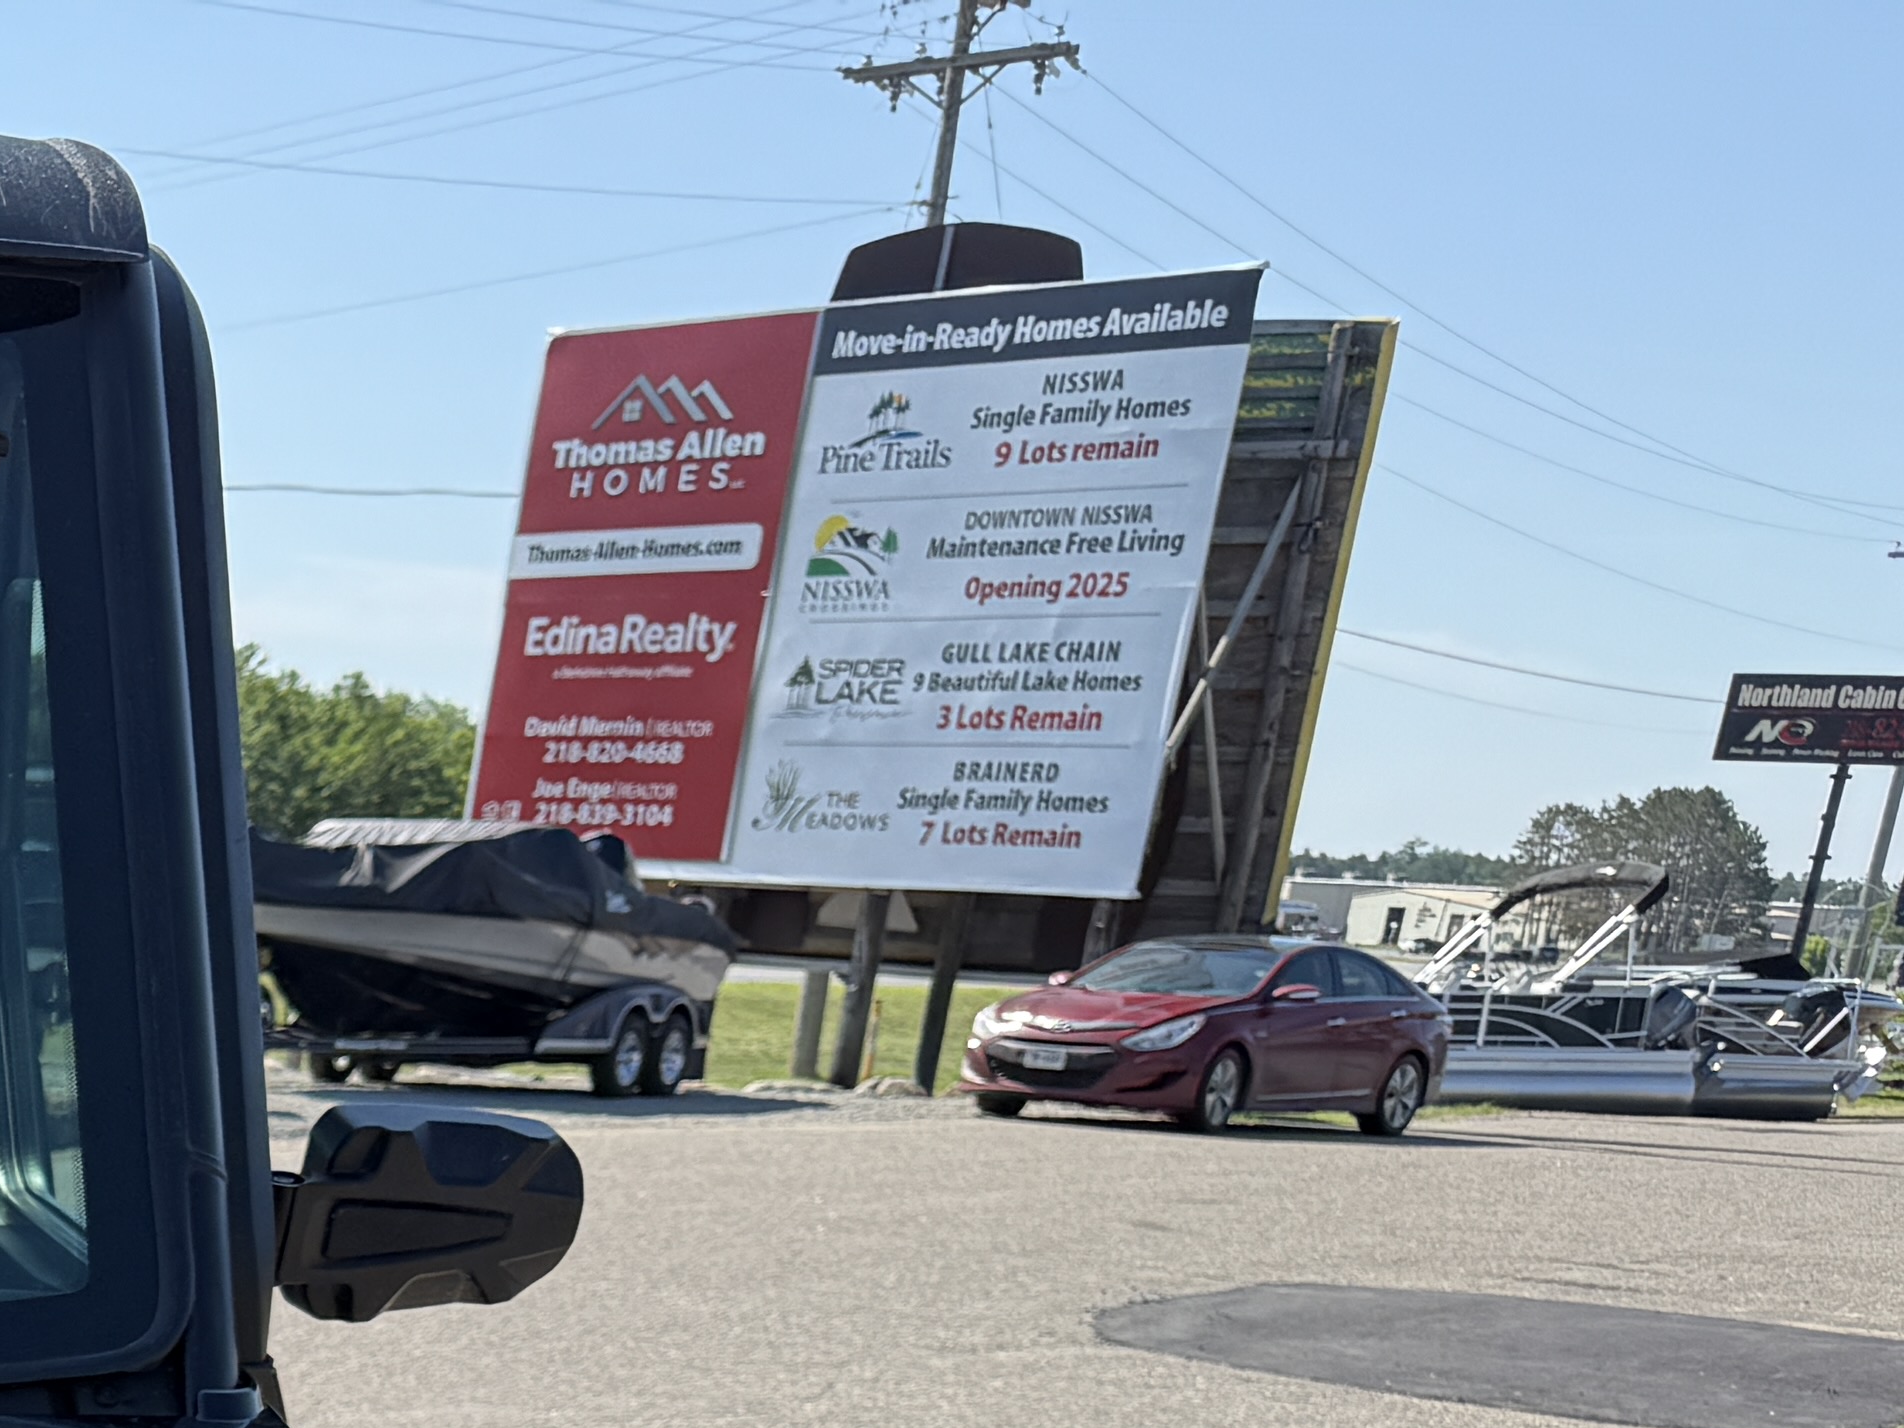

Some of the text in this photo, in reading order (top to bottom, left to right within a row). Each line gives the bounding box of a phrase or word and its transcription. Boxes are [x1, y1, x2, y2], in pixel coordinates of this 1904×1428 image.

[832, 299, 1230, 360] Move-in-Ready Homes Available
[1042, 368, 1125, 396] NISSWA
[970, 397, 1191, 433] Single Family Homes
[552, 427, 767, 470] Thomas Allen
[817, 440, 953, 475] Pine Trails
[993, 432, 1160, 468] 9 Lots remain
[569, 462, 732, 499] HOMES
[964, 504, 1153, 531] DOWNTOWN NISSWA
[926, 530, 1185, 560] Maintenance Free Living
[800, 579, 890, 601] NISSWA
[964, 571, 1131, 605] Opening 2025
[941, 640, 1122, 664] GULL LAKE CHAIN
[817, 658, 906, 680] SPIDER
[913, 669, 1143, 692] 9 Beautiful Lake Homes
[814, 680, 903, 705] LAKE
[1738, 683, 1837, 709] Northland
[1838, 684, 1896, 710] Cabin
[524, 715, 578, 737] David
[936, 706, 952, 730] 3
[955, 706, 1006, 730] Lots
[1010, 703, 1103, 731] Remain
[952, 761, 1060, 783] BRAINERD
[826, 790, 861, 809] THE
[897, 786, 1110, 815] Single Family Homes
[918, 821, 1082, 849] 7 Lots Remain
